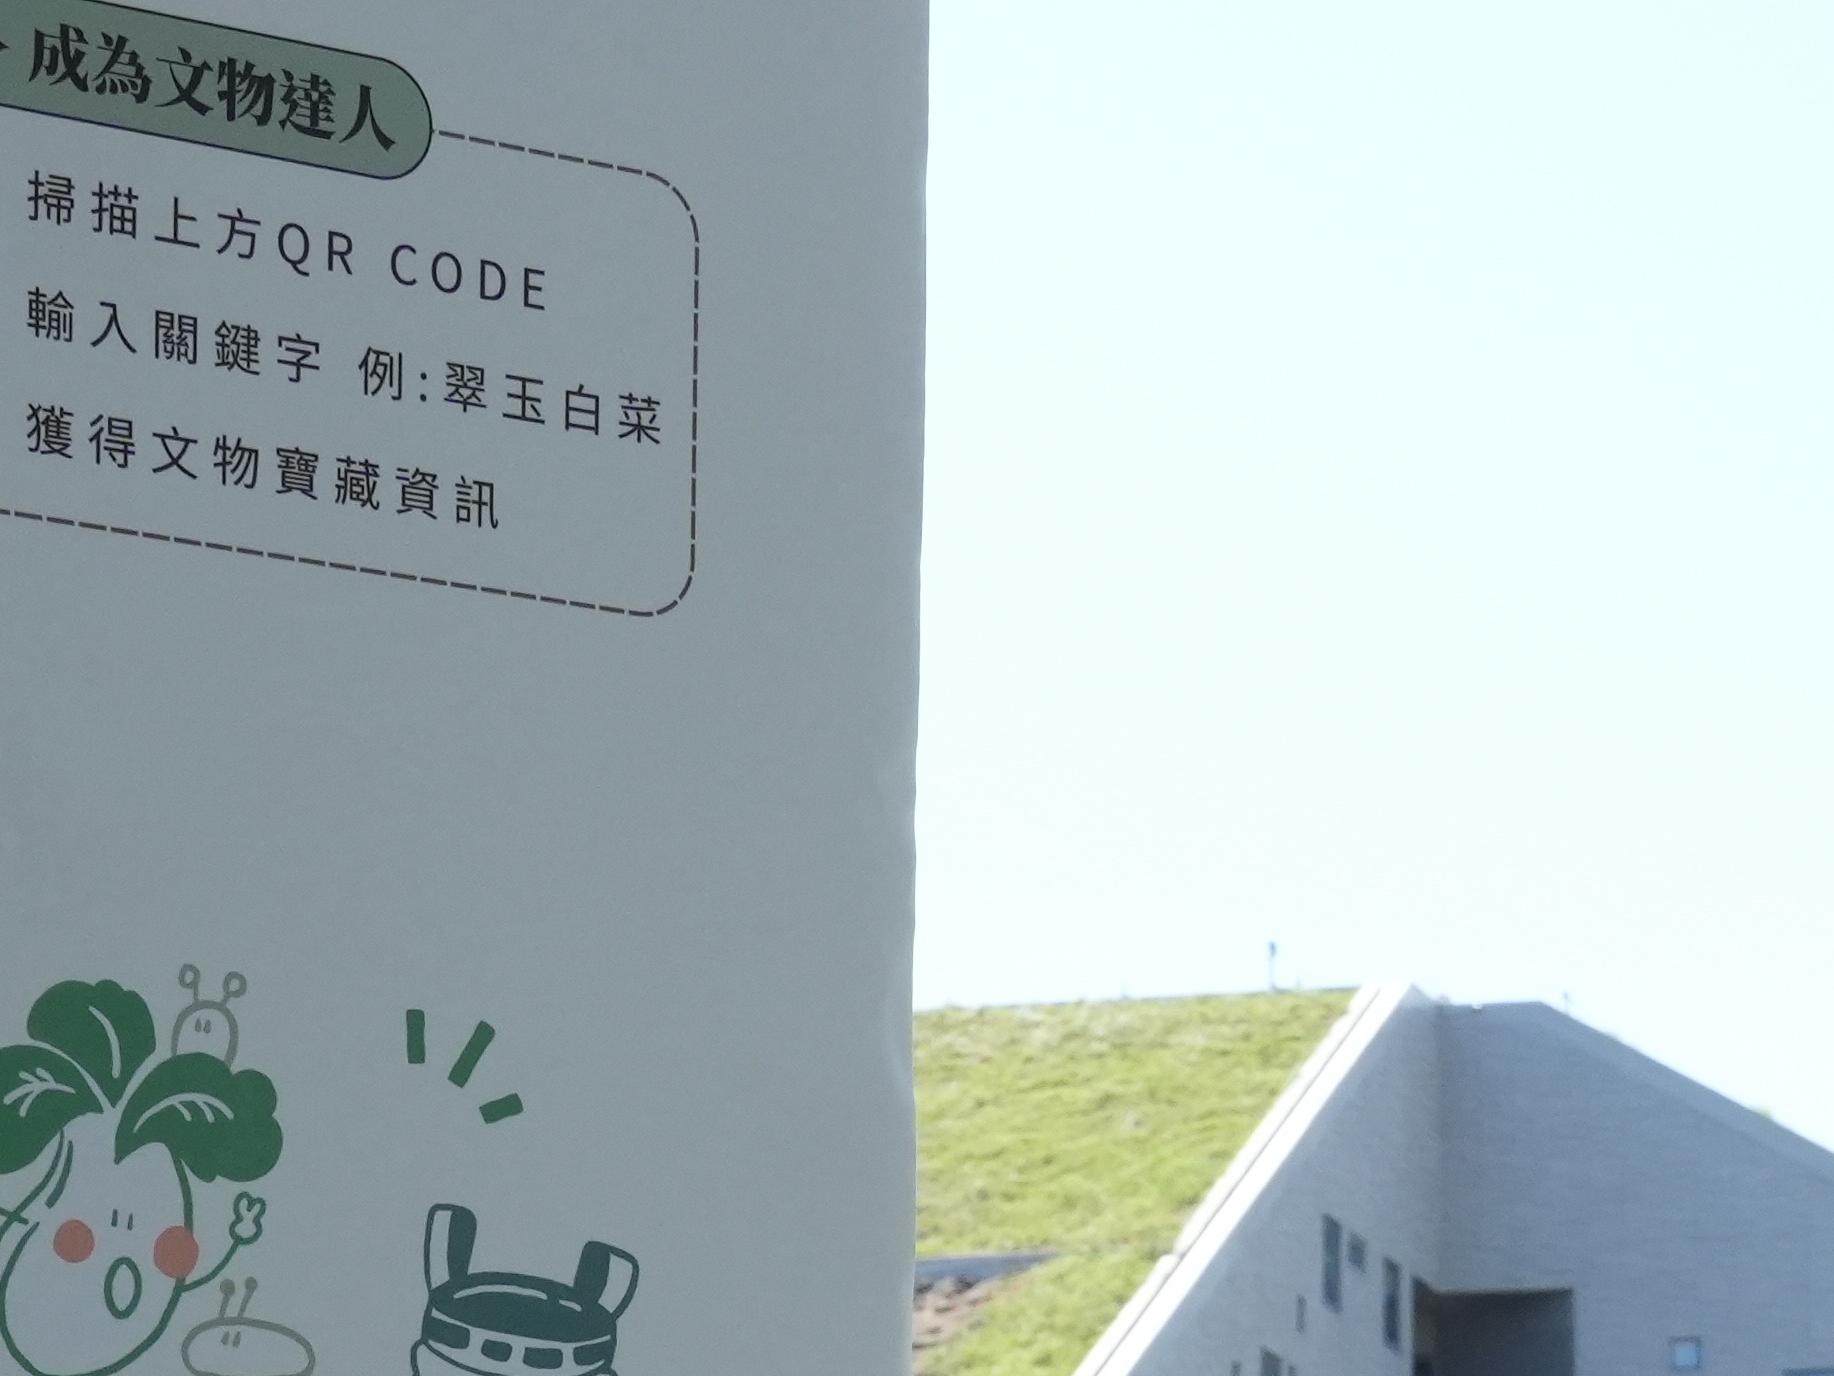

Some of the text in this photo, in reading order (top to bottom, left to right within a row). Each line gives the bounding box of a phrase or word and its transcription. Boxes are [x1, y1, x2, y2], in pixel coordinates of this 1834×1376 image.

[28, 23, 396, 152] 成為文物達人
[27, 170, 352, 277] 掃描上方QR
[391, 244, 545, 311] CODE
[26, 286, 320, 383] 輸入關鍵字
[26, 403, 498, 529] 獲得文物寶藏資訊
